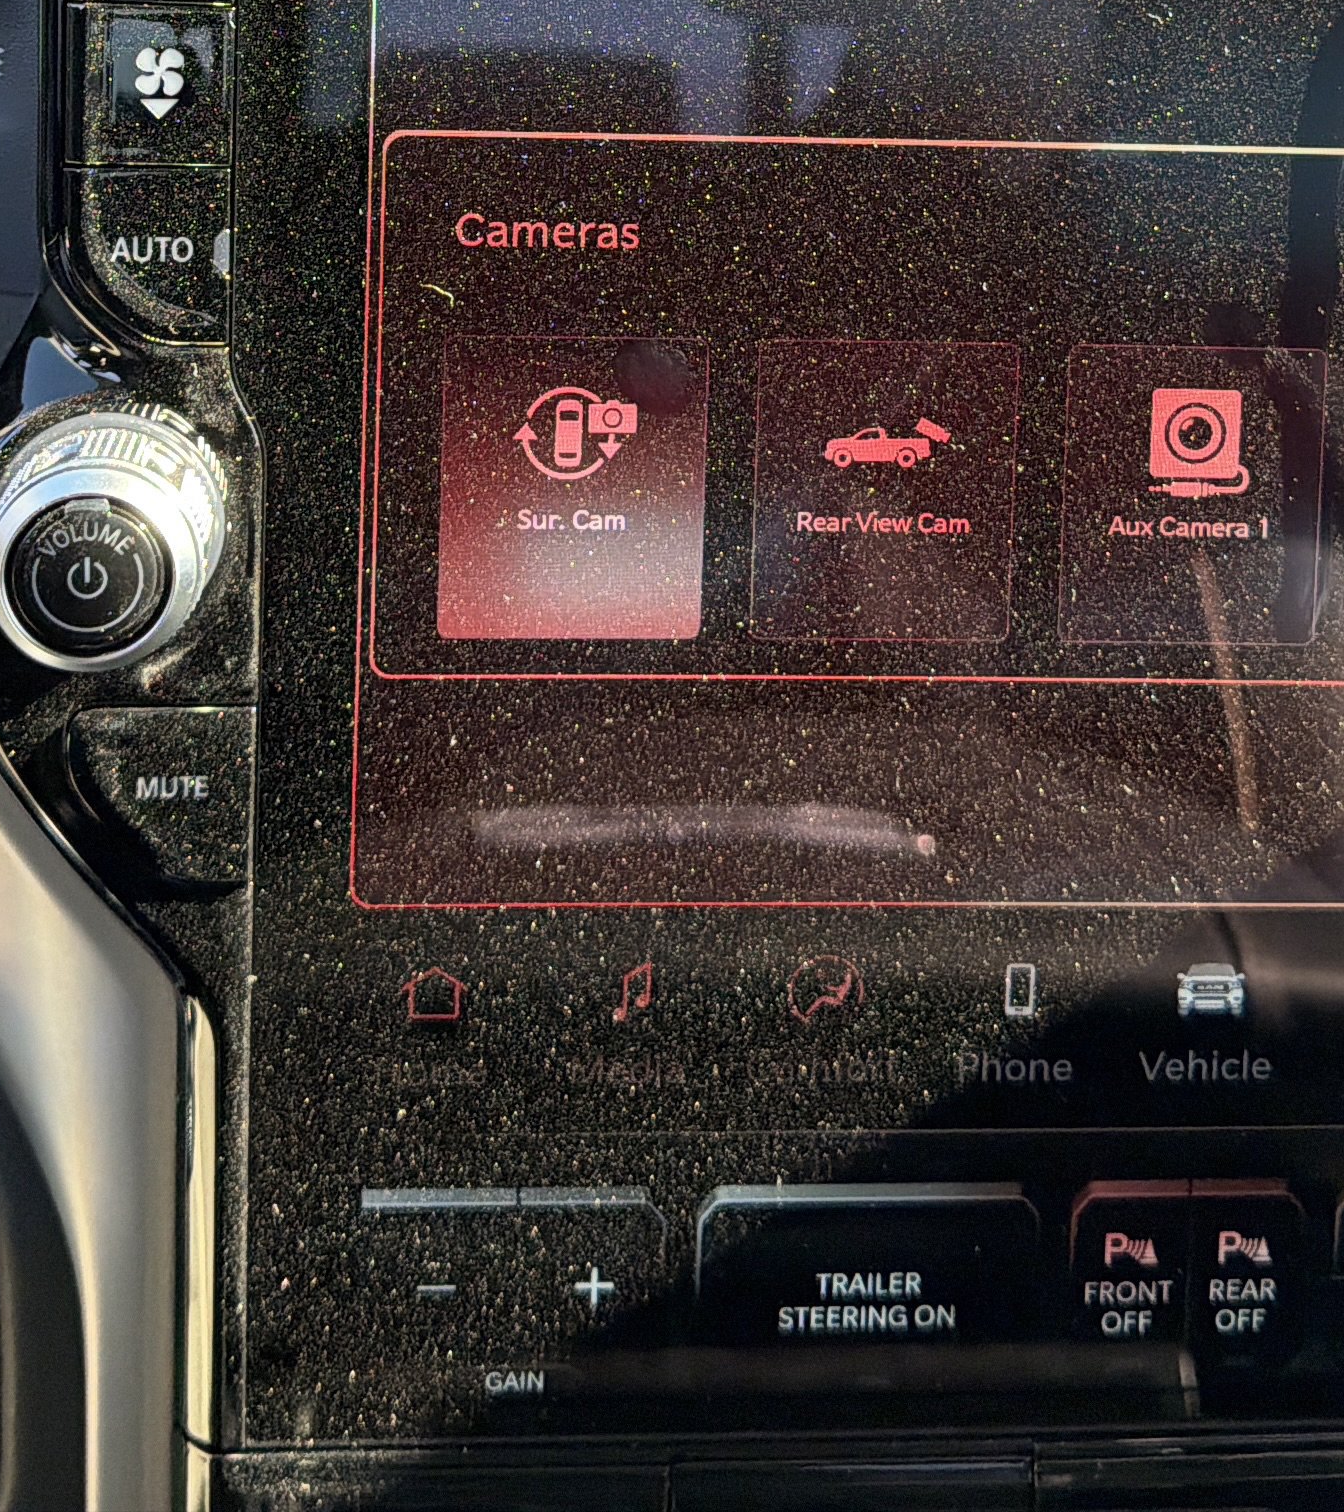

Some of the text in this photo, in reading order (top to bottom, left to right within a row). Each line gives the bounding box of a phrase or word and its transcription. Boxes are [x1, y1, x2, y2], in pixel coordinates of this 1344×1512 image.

[456, 212, 641, 251] Cameras
[110, 236, 195, 263] AUTO
[516, 509, 626, 532] Sur. Cam
[797, 510, 970, 535] Rear View Cam
[1108, 515, 1270, 540] Aux Camera 1
[37, 521, 136, 558] VOLUME
[135, 775, 210, 800] MUTE
[957, 1048, 1074, 1082] Phone
[1138, 1048, 1273, 1082] Vehicle
[816, 1271, 922, 1299] TRAILER
[1084, 1279, 1174, 1306] FRONT
[1208, 1277, 1277, 1303] REAR
[777, 1304, 956, 1332] STEERING ON
[1100, 1310, 1153, 1337] OFF
[1214, 1308, 1266, 1334] OFF
[484, 1370, 545, 1393] GAIN
